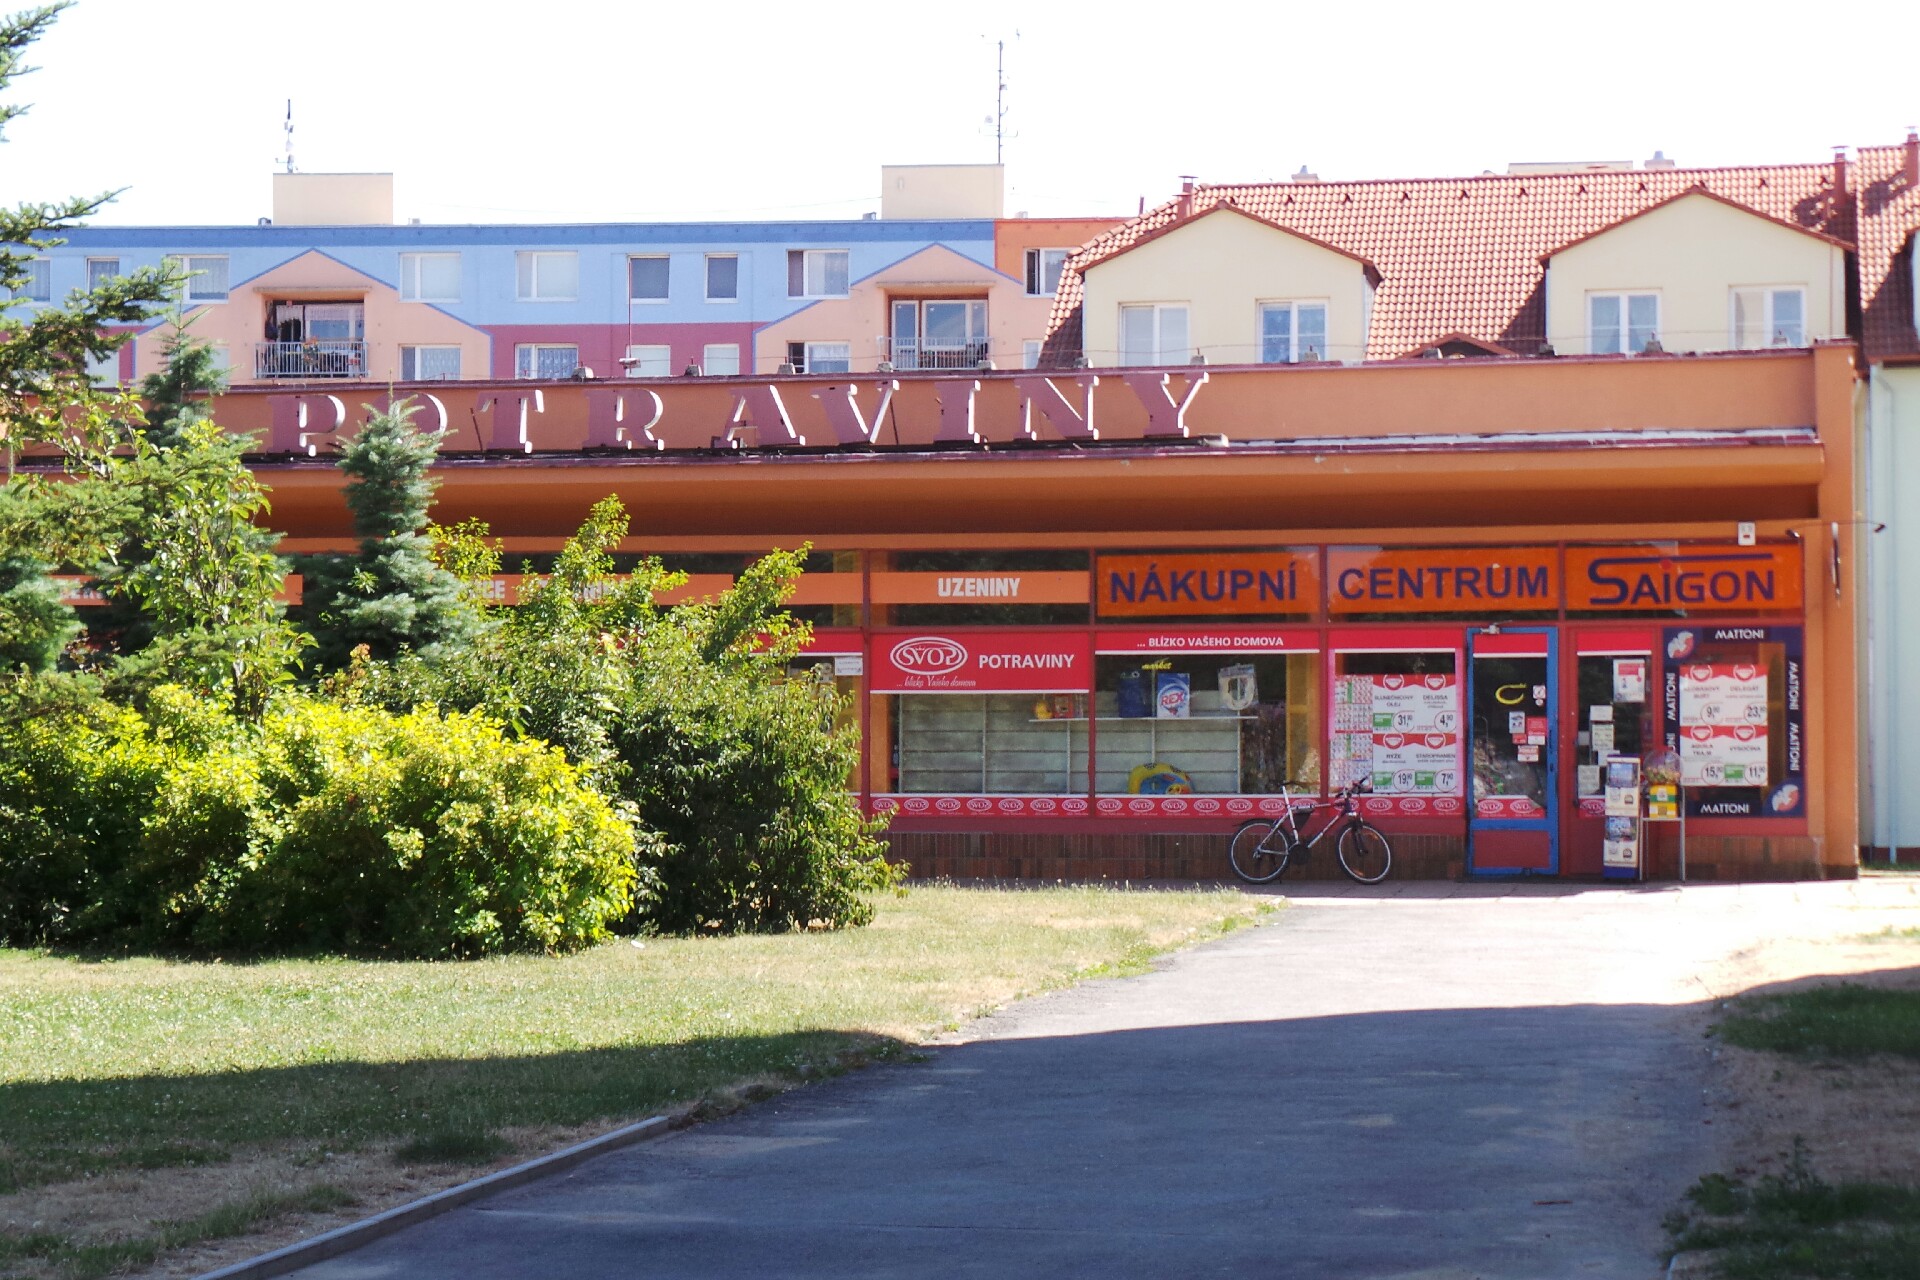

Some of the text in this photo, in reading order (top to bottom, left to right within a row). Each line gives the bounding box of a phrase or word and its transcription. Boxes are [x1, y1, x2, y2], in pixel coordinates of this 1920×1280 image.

[937, 577, 1021, 597] UZENINY
[1110, 562, 1549, 602] NÁKUPNÍ CENTRUM
[1588, 553, 1774, 605] SAIGON
[1148, 636, 1186, 647] BLÍZKO
[1188, 636, 1231, 647] VAŠEHO
[1233, 637, 1284, 647] DOMOVA
[1714, 629, 1764, 639] MATTONI
[978, 654, 1075, 668] POTRAVINY
[1789, 661, 1799, 710] MATTONI
[1161, 690, 1185, 706] REX
[1666, 672, 1676, 721] MATTONI
[1789, 722, 1799, 771] MATTONI
[1700, 803, 1749, 813] MATTONI
